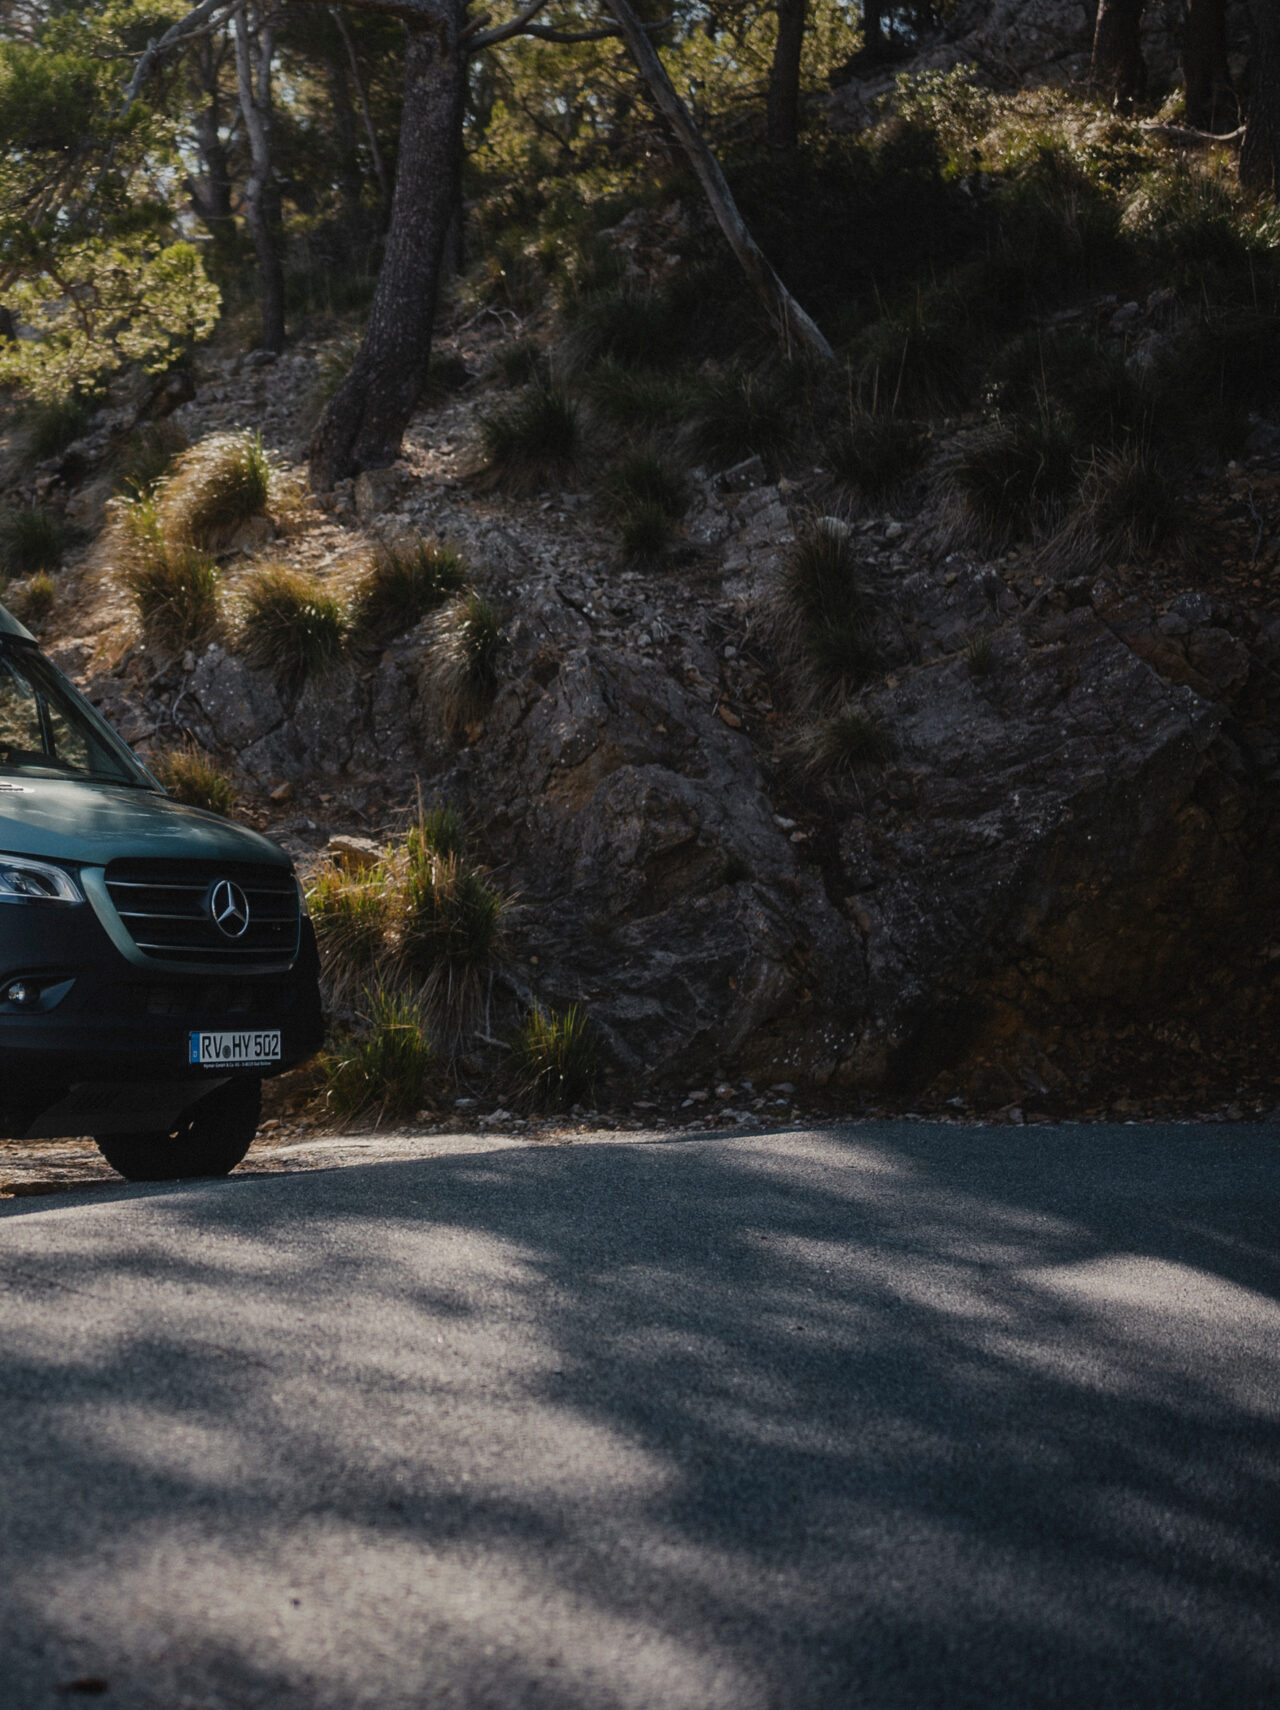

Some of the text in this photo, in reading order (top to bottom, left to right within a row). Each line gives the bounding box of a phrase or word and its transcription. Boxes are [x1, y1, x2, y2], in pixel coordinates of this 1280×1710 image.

[202, 1034, 279, 1059] RV HY 502
